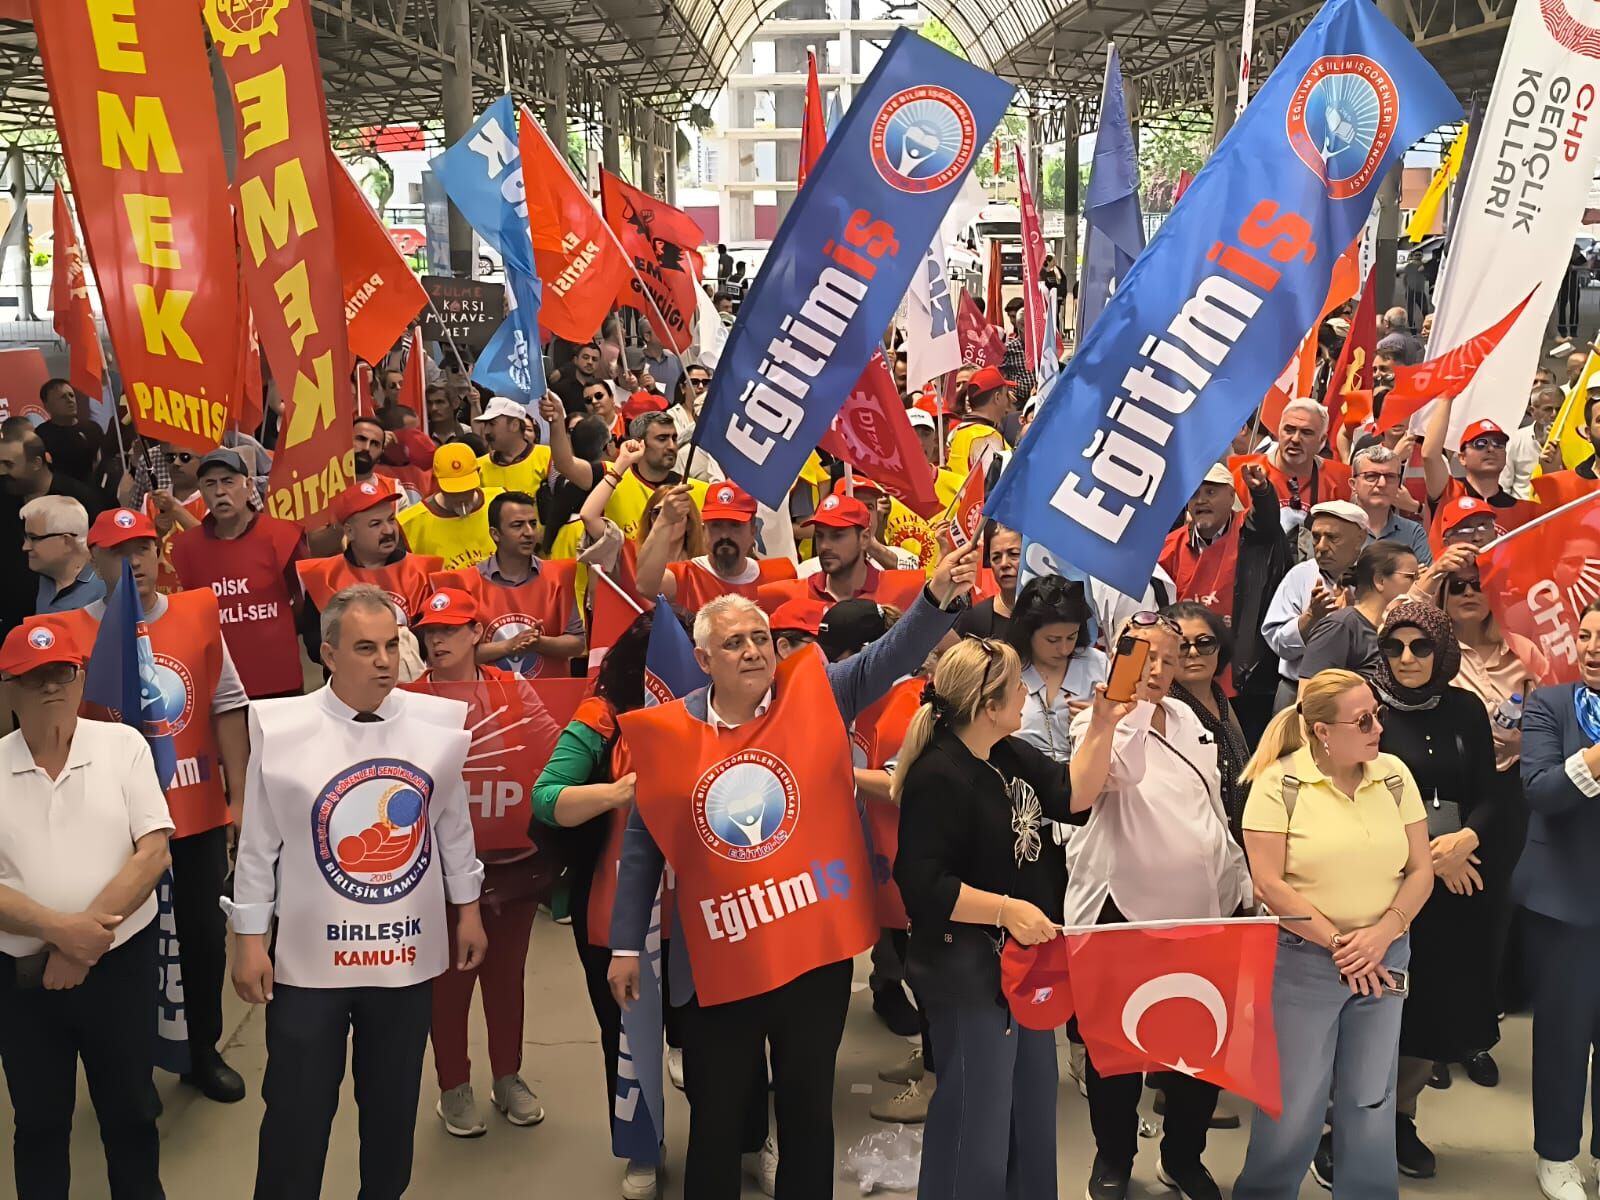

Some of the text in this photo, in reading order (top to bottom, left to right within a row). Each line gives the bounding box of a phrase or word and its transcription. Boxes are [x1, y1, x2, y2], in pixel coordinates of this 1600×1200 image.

[1311, 64, 1326, 77] VE
[886, 101, 899, 113] VE
[1564, 83, 1595, 162] CHP
[1484, 68, 1543, 218] KOLLARI
[1512, 76, 1571, 234] GENÇLİK
[86, 0, 203, 364] EMEK
[211, 577, 250, 598] DİSK
[219, 602, 278, 625] KLİ-SEN
[1527, 579, 1578, 665] CHP
[466, 781, 523, 818] HP
[696, 801, 703, 814] VE
[325, 862, 379, 898] BİRLEŞİK
[370, 872, 393, 882] 2008
[327, 916, 422, 943] BİRLEŞİK
[334, 944, 417, 967] KAMU-İŞ
